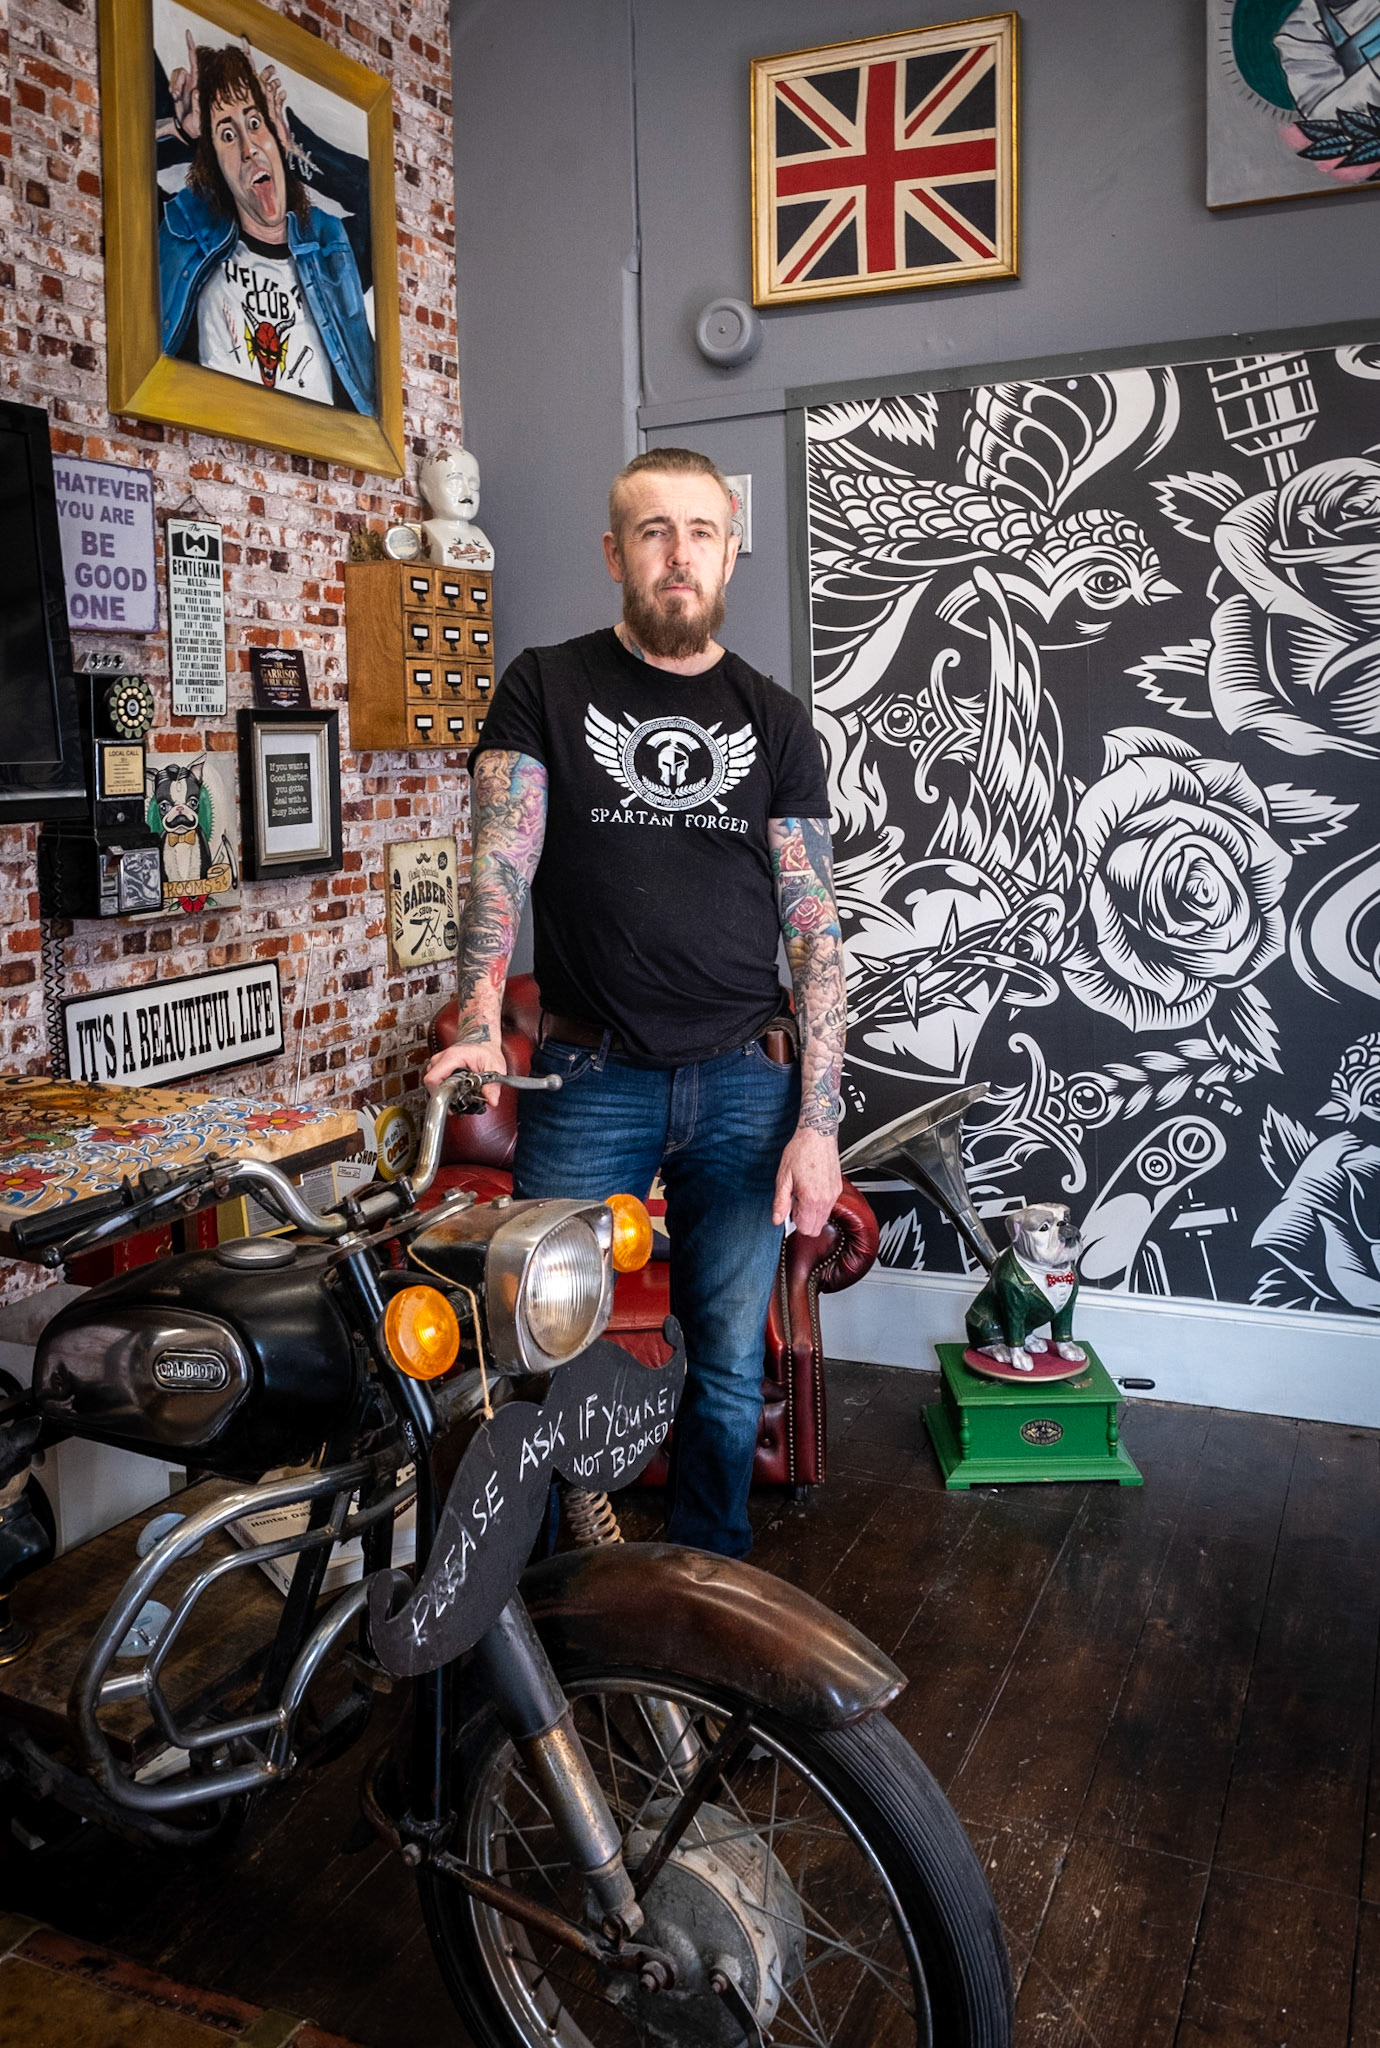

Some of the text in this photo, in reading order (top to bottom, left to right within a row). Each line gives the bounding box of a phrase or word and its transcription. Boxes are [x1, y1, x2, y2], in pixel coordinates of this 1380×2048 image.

[246, 290, 290, 319] CLUB
[54, 470, 149, 502] HATEVER
[57, 499, 135, 526] YOU ARE
[187, 523, 201, 532] The
[81, 530, 115, 558] BE
[75, 562, 148, 592] GOOD
[172, 559, 221, 579] GENTLEMAN
[187, 577, 207, 587] RULES
[70, 593, 126, 621] ONE
[261, 669, 299, 678] GARRISON
[175, 704, 223, 712] STAY HUMBLE
[269, 763, 275, 771] If
[275, 763, 287, 772] you
[288, 762, 303, 770] want
[270, 774, 286, 782] Good
[276, 785, 304, 795] you gotta
[274, 797, 287, 805] deal
[288, 795, 301, 804] with
[272, 808, 287, 817] Busy
[591, 808, 749, 834] SPARTAN FORGED
[166, 880, 212, 898] ROOMS
[404, 880, 446, 915] BARBER
[419, 906, 432, 917] SHOP
[76, 980, 275, 1081] IT'S A BEAUTIFUL LIFE
[358, 1150, 378, 1166] SHOP
[573, 1449, 605, 1477] NOT
[250, 1516, 289, 1528] Hunter
[412, 1471, 504, 1646] PLEASE
[519, 1409, 565, 1483] ASK
[579, 1393, 599, 1441] IF
